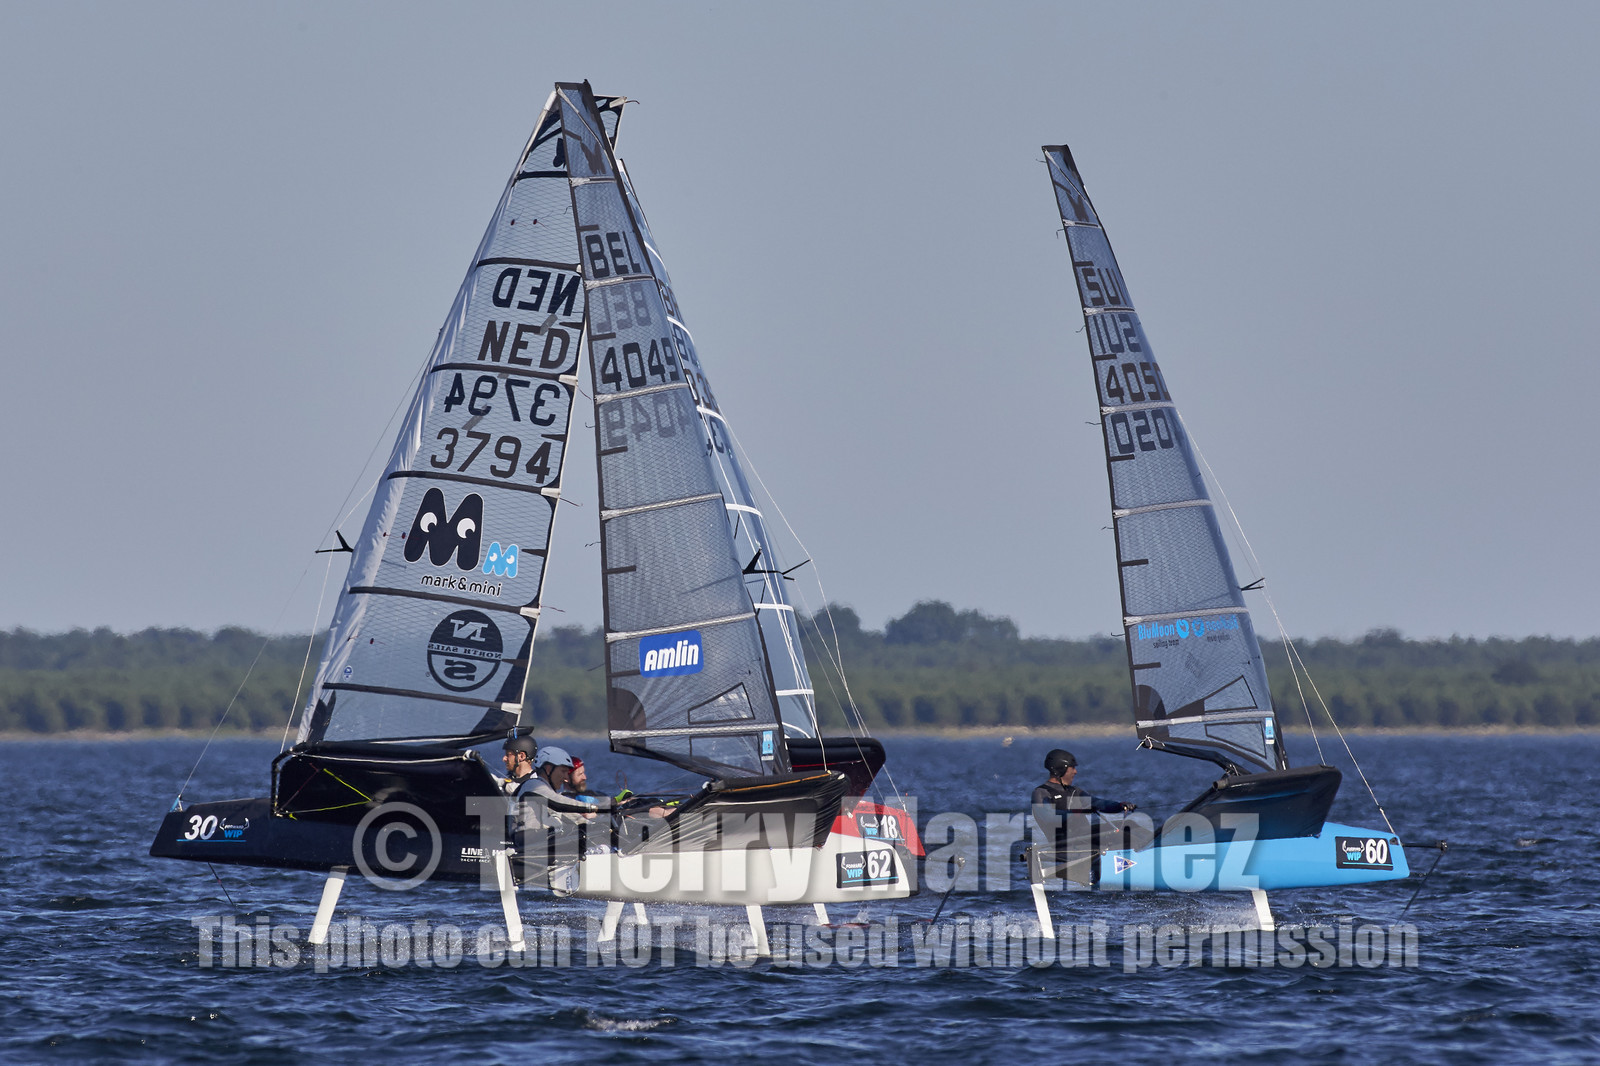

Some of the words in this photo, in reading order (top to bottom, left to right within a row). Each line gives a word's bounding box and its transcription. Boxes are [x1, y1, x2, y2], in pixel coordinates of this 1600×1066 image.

[585, 231, 642, 278] BEL
[477, 320, 571, 369] NED
[601, 337, 681, 391] 4049
[430, 427, 553, 484] 3794
[1137, 621, 1175, 640] BluMoon
[644, 640, 699, 671] Amlin
[184, 814, 218, 840] 30
[224, 829, 243, 838] WIP
[865, 827, 878, 835] WIP
[881, 815, 898, 838] 18
[461, 847, 483, 856] LINE
[1346, 852, 1361, 861] WIP
[1366, 838, 1388, 864] 60
[846, 868, 863, 878] WIP
[867, 850, 892, 879] 62
